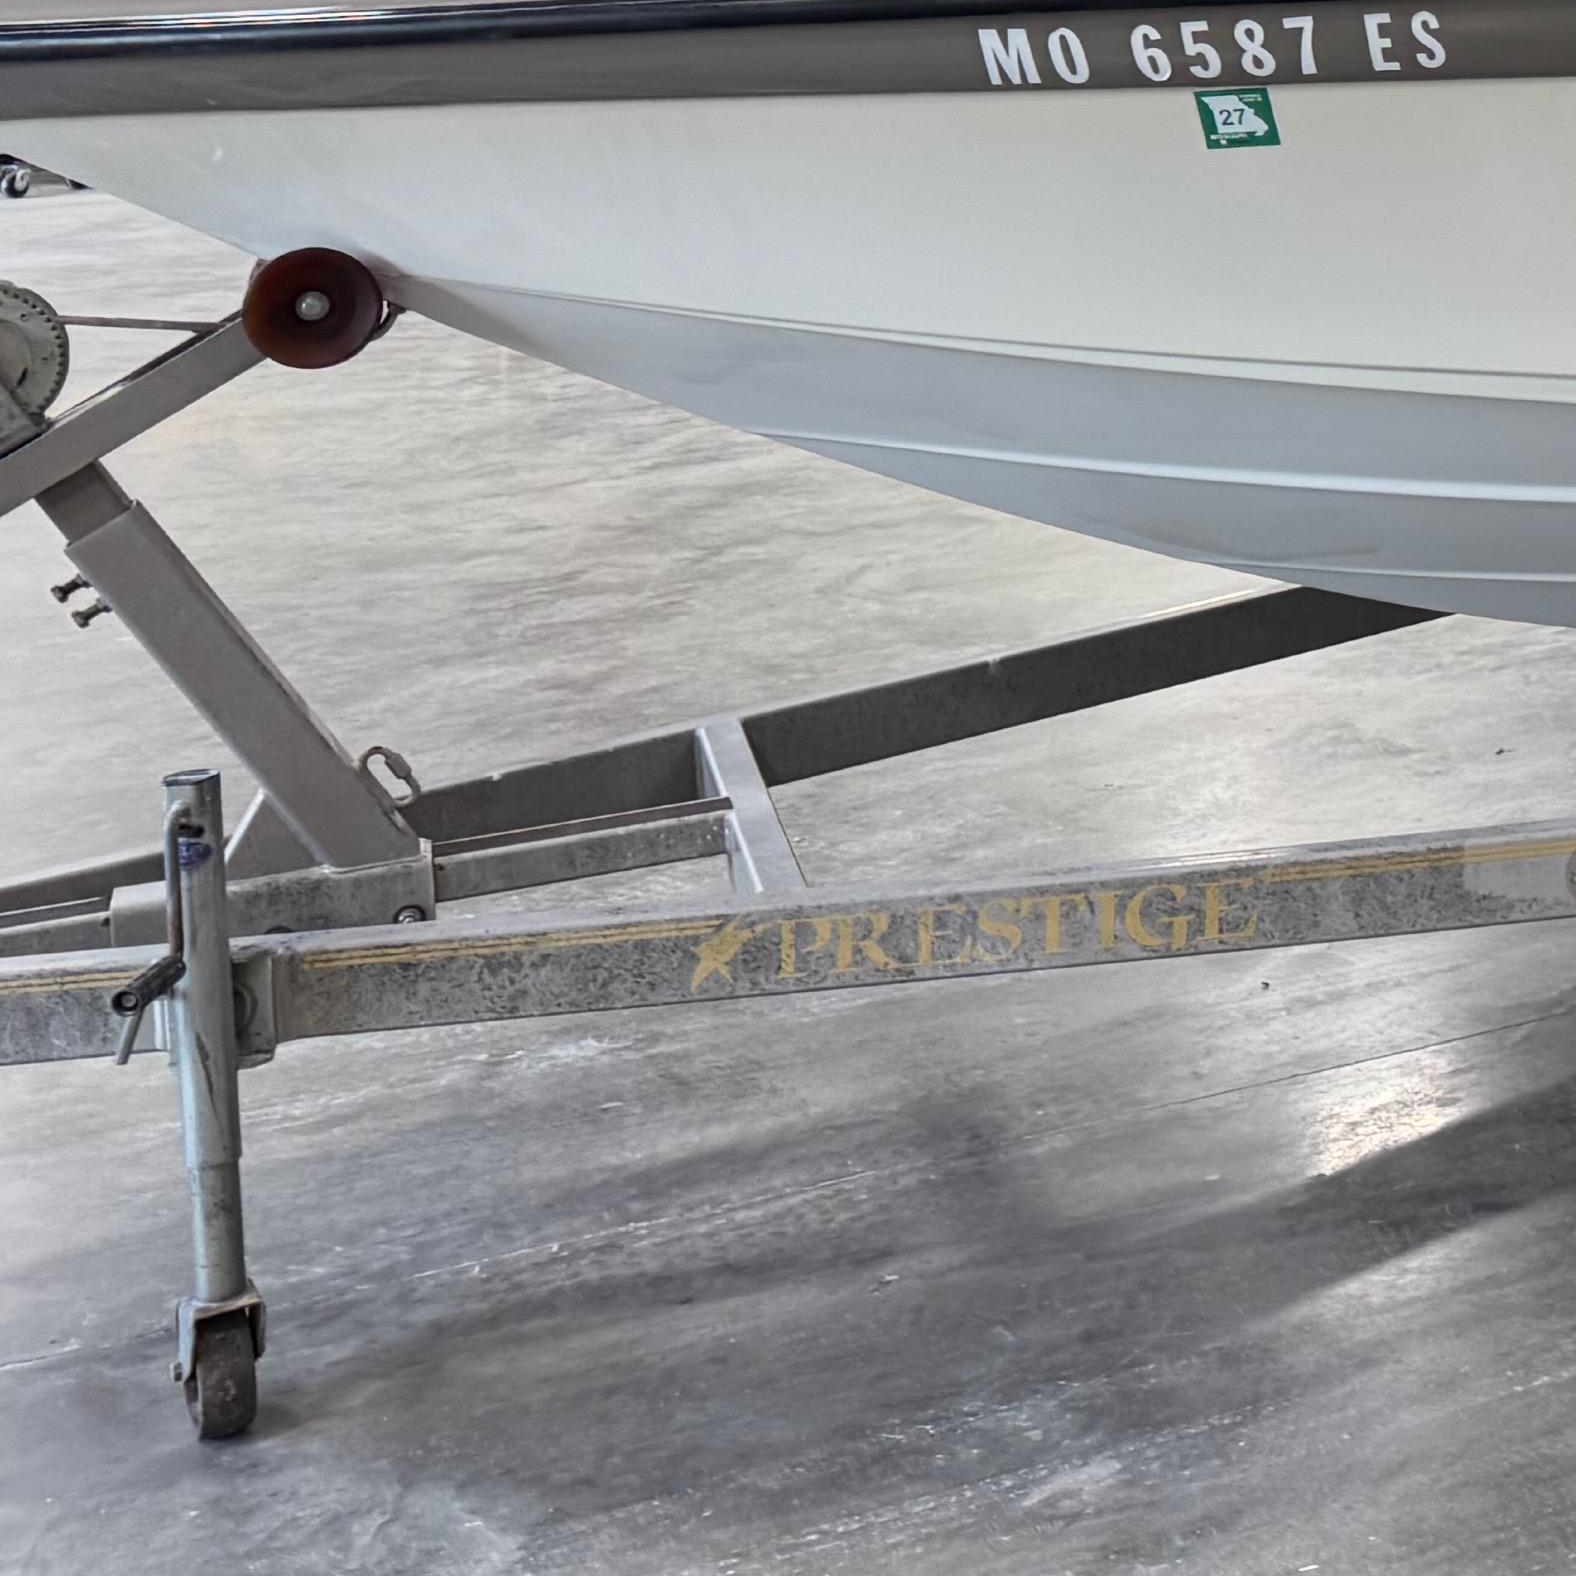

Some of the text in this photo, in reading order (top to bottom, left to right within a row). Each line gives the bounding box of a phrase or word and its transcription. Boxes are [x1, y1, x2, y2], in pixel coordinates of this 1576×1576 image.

[977, 10, 1447, 86] MO 6587 ES
[1219, 108, 1245, 126] 27
[776, 877, 1257, 979] PRESTIGE
